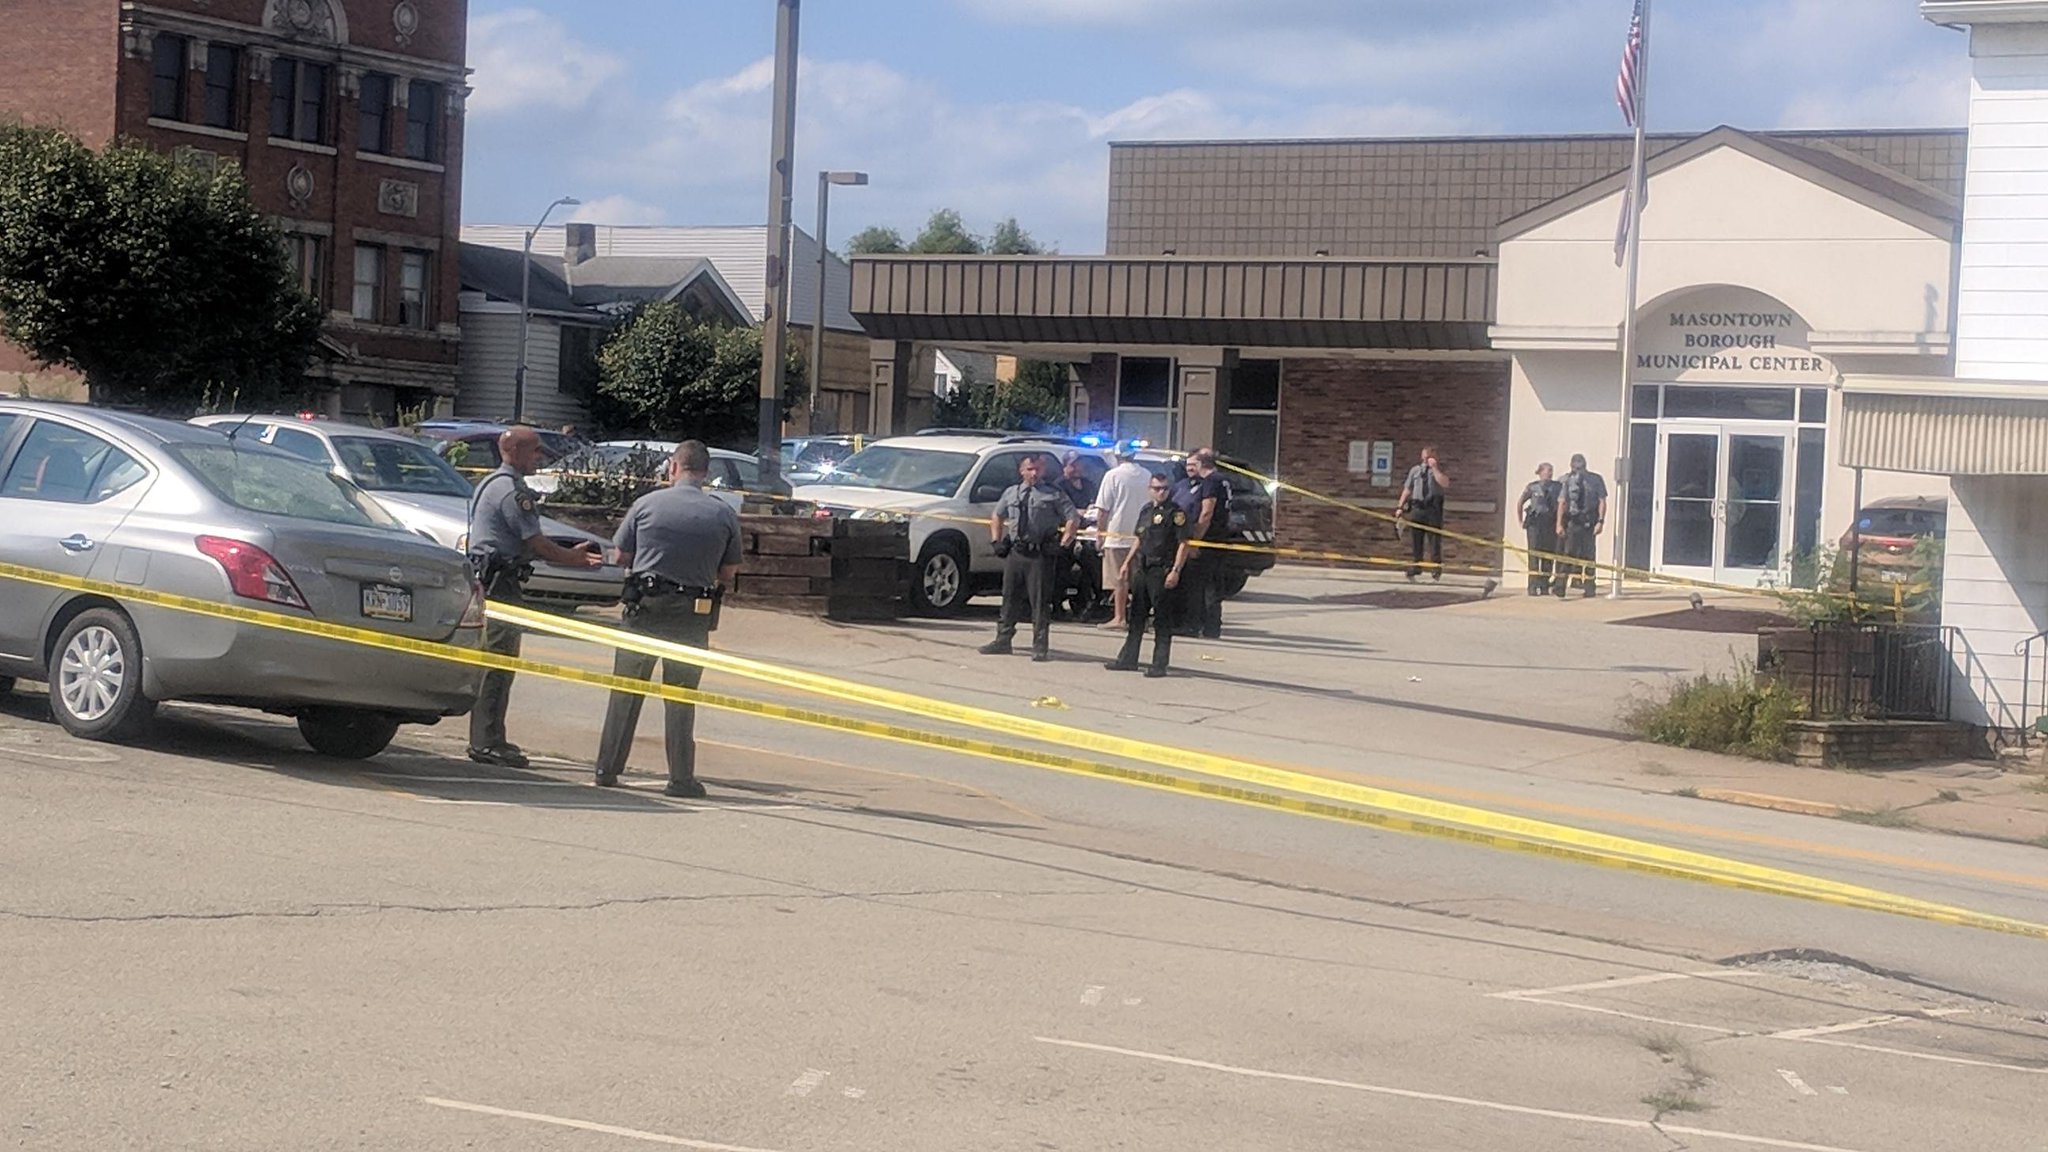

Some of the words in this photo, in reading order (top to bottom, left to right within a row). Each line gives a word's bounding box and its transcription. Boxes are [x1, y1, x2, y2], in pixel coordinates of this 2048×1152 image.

[1669, 313, 1793, 327] MASONTOWN
[1685, 334, 1776, 348] BOROUGH
[1636, 355, 1743, 370] MUNICIPAL
[1750, 356, 1824, 371] CENTER
